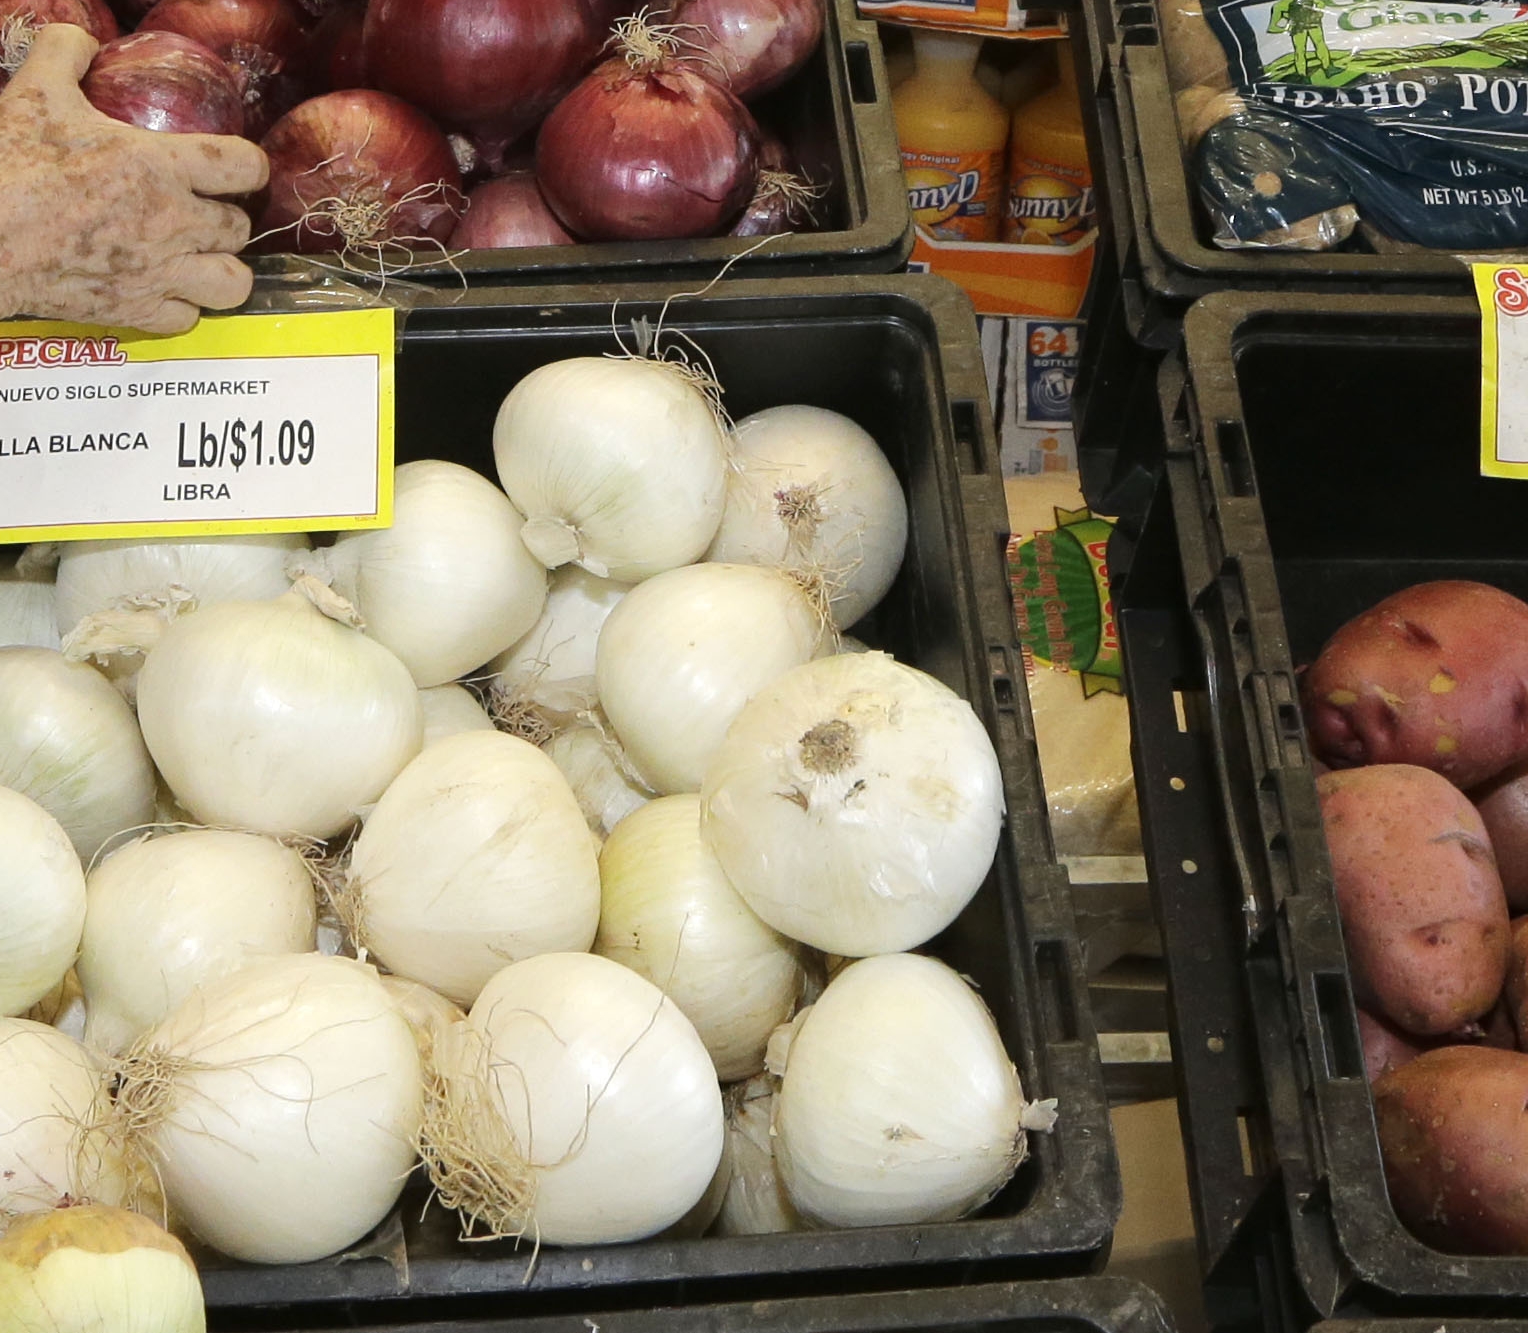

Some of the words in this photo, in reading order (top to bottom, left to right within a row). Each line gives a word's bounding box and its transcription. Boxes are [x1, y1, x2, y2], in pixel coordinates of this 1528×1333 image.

[1336, 2, 1492, 32] Giant
[919, 153, 960, 164] Original
[1450, 160, 1482, 177] U.S.
[908, 170, 980, 211] nnyD
[1422, 188, 1451, 205] NET
[1454, 189, 1478, 205] WT
[1481, 189, 1493, 206] 5
[1493, 189, 1512, 205] LB
[1029, 331, 1070, 356] 64
[65, 384, 122, 400] SIGLO
[127, 380, 272, 398] SUPERMARKET
[49, 431, 150, 454] BLANCA
[177, 417, 316, 473] Lb/$1.09
[162, 483, 232, 502] LIBRA
